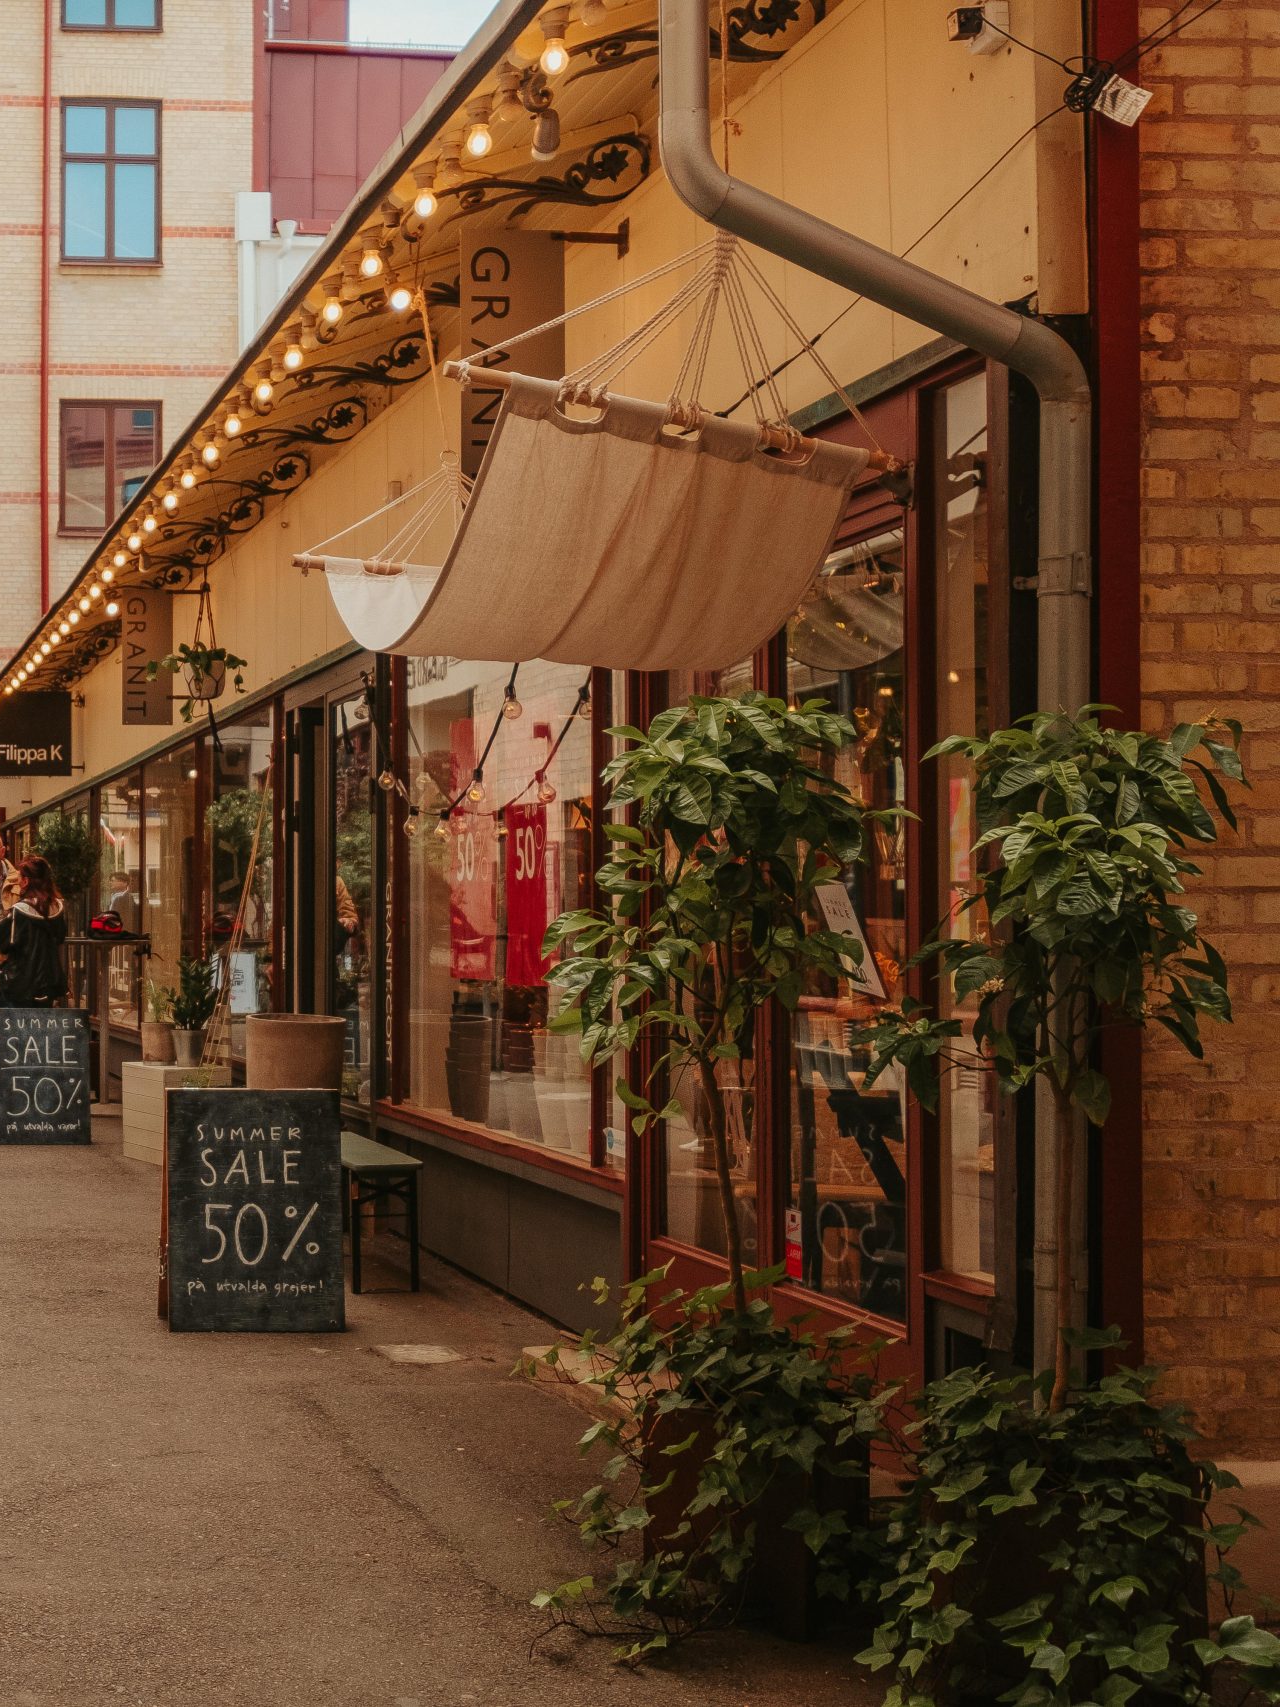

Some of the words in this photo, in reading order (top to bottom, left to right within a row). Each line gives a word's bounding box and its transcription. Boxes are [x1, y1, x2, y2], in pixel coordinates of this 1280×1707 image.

[127, 597, 146, 717] GRANIT
[50, 744, 63, 760] K
[457, 831, 488, 881] 50%
[385, 881, 393, 1063] GRANIT.COM
[3, 1018, 84, 1030] SUMMER
[3, 1035, 78, 1064] SALE
[6, 1075, 82, 1116] 50%
[6, 1121, 18, 1134] på
[196, 1124, 302, 1142] SUMMER
[200, 1148, 302, 1187] SALE
[187, 1277, 206, 1295] på
[216, 1279, 268, 1293] utvalda
[274, 1279, 323, 1297] grejer!
